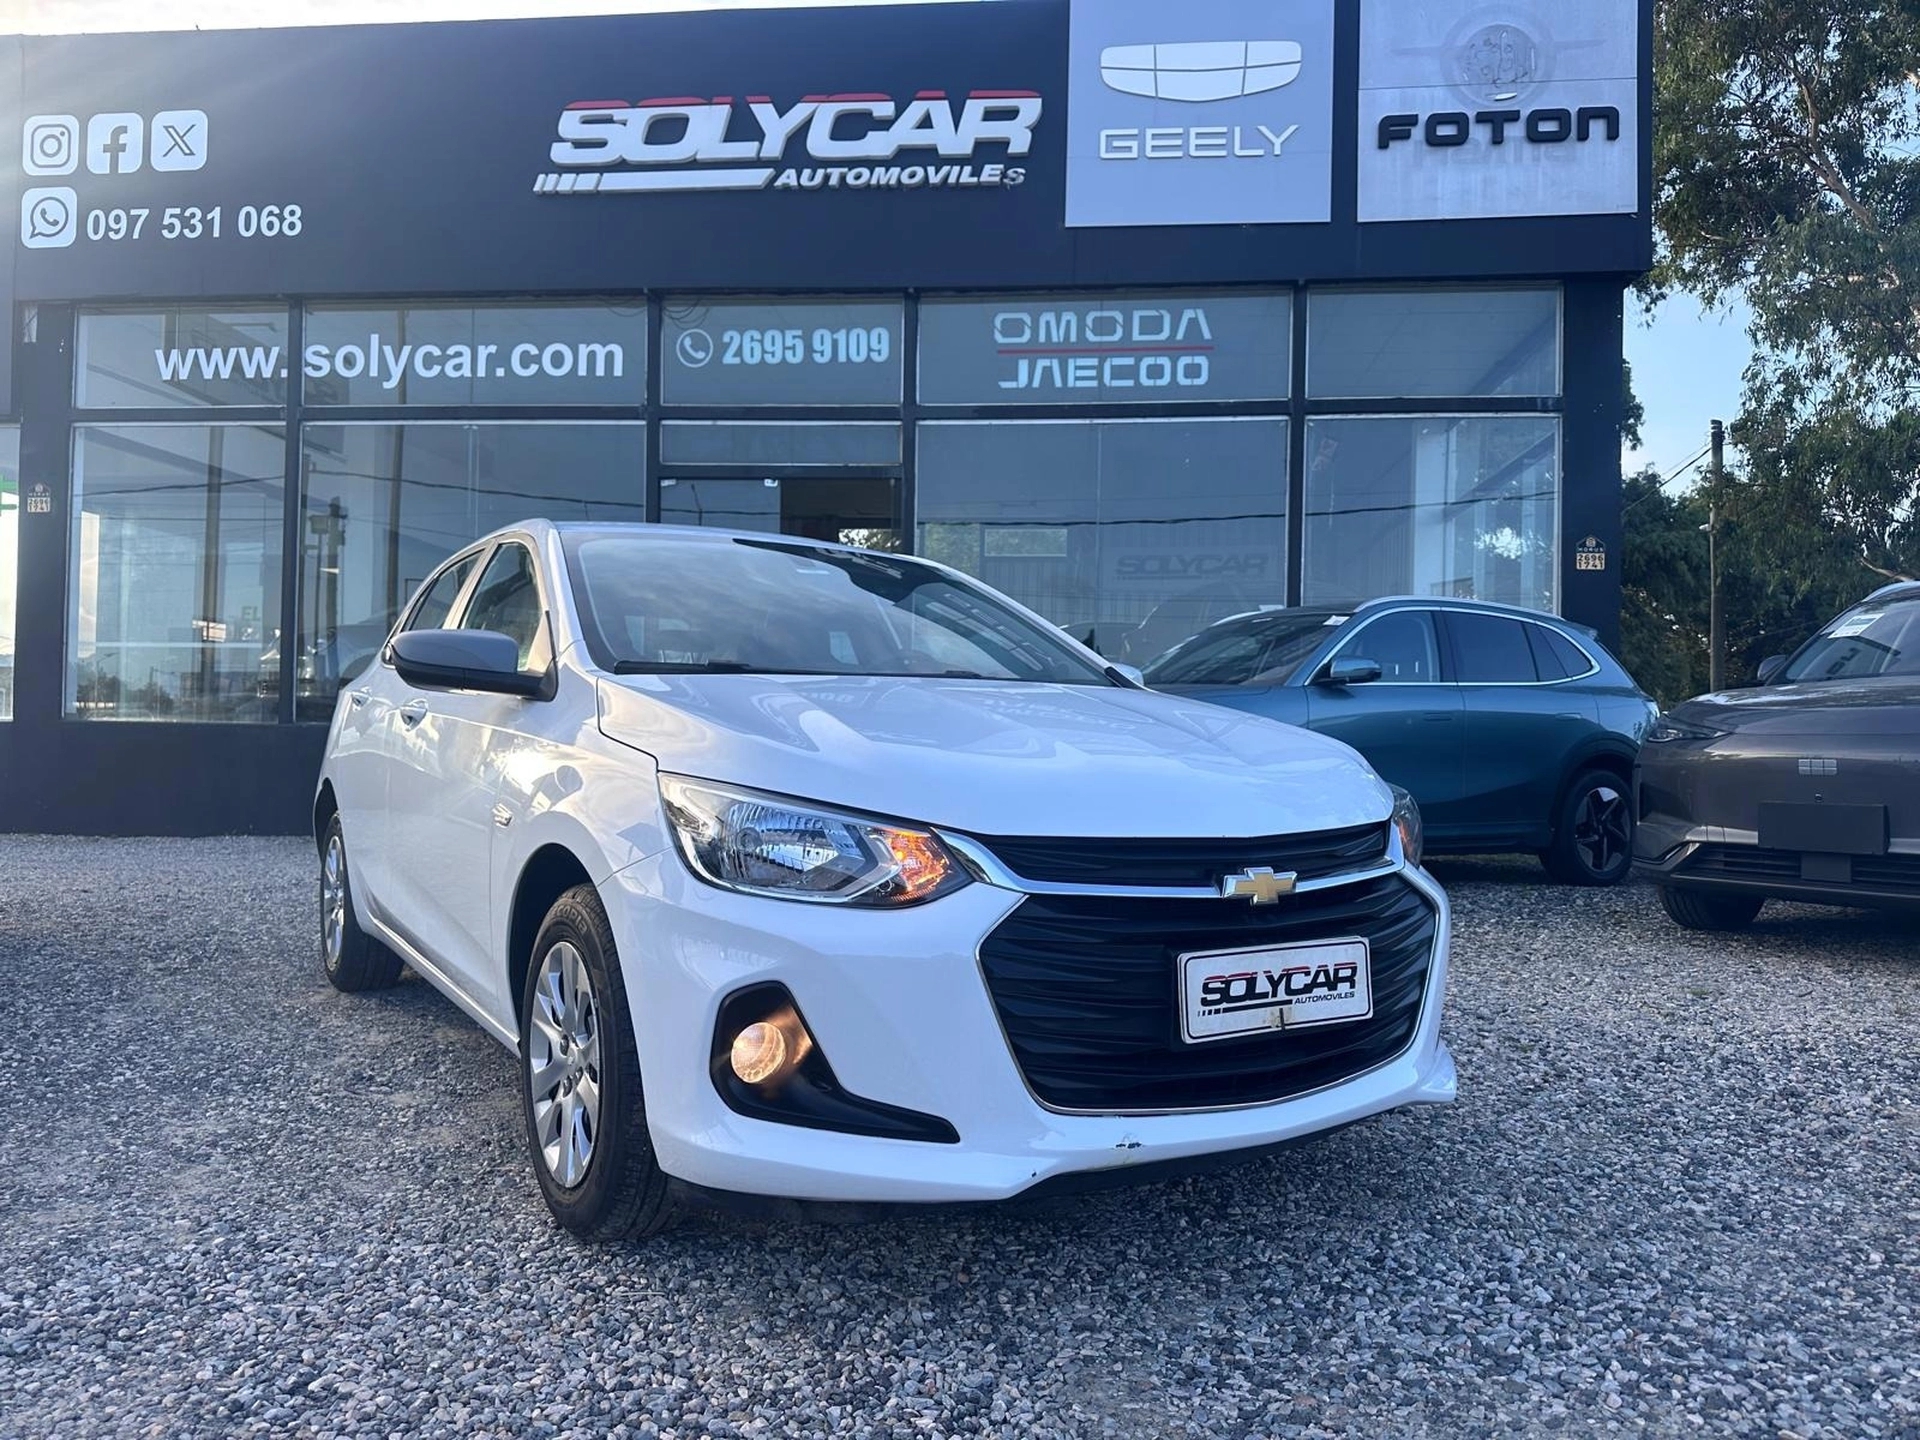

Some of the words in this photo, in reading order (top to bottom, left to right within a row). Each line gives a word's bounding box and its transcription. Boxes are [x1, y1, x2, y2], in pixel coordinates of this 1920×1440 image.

[550, 89, 1045, 165] SOLYCAR
[1099, 125, 1299, 160] GEELY
[1377, 106, 1621, 150] FOTON
[774, 164, 1027, 189] AUTOMOVILES
[86, 208, 150, 240] 097
[161, 207, 221, 239] 531
[237, 205, 303, 237] 068
[993, 307, 1214, 344] OMODA
[722, 329, 804, 365] 2695
[812, 327, 890, 363] 9109
[997, 355, 1209, 390] JAECOO
[1115, 553, 1269, 575] SOLYCAR
[1200, 961, 1358, 1007] SOLYCAR
[1293, 990, 1356, 1005] AUTOMOVILES
